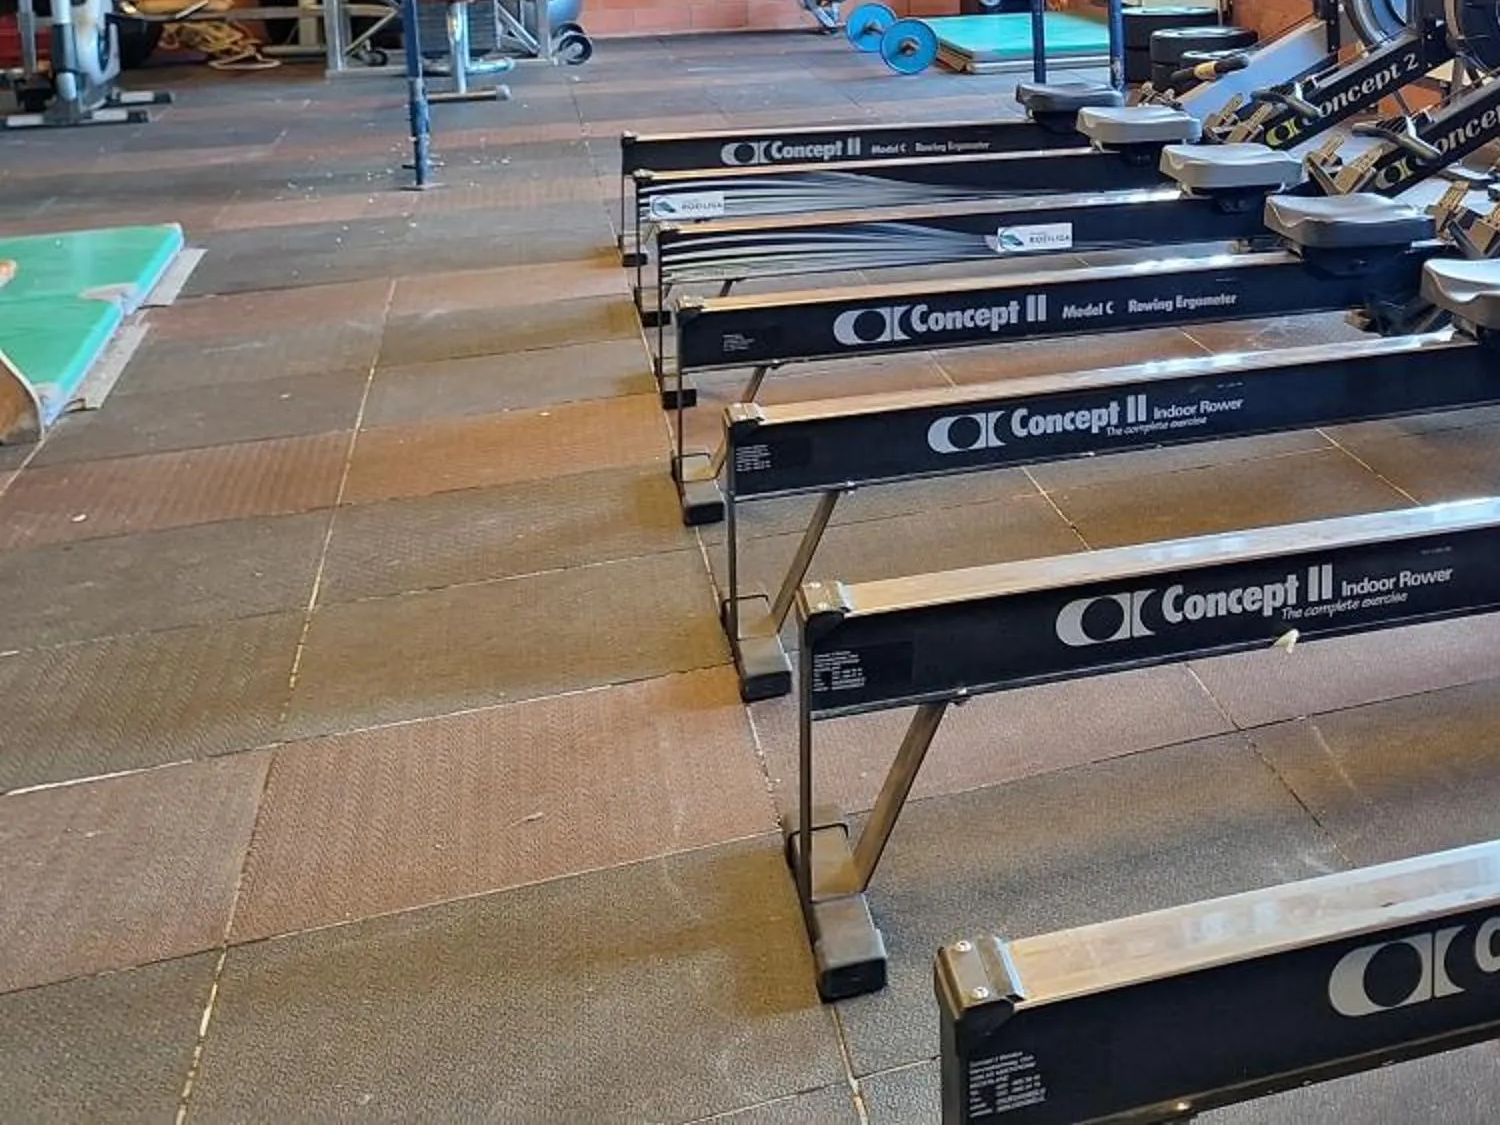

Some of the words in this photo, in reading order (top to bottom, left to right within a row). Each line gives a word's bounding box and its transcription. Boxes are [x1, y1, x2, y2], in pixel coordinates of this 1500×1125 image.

[1302, 62, 1401, 125] oncept
[1403, 52, 1420, 71] 2
[771, 139, 843, 161] Concept
[909, 300, 1021, 333] Concept
[1062, 303, 1104, 320] Model
[1128, 297, 1174, 315] Rowing
[1010, 399, 1121, 439] Concept
[1152, 402, 1199, 421] Indoor
[1199, 396, 1245, 414] Rower
[1106, 424, 1123, 438] The
[1161, 572, 1299, 625] Concept
[1341, 575, 1396, 599] Indoor
[1398, 566, 1453, 589] Rower
[1281, 605, 1302, 621] The
[1303, 598, 1361, 619] complete
